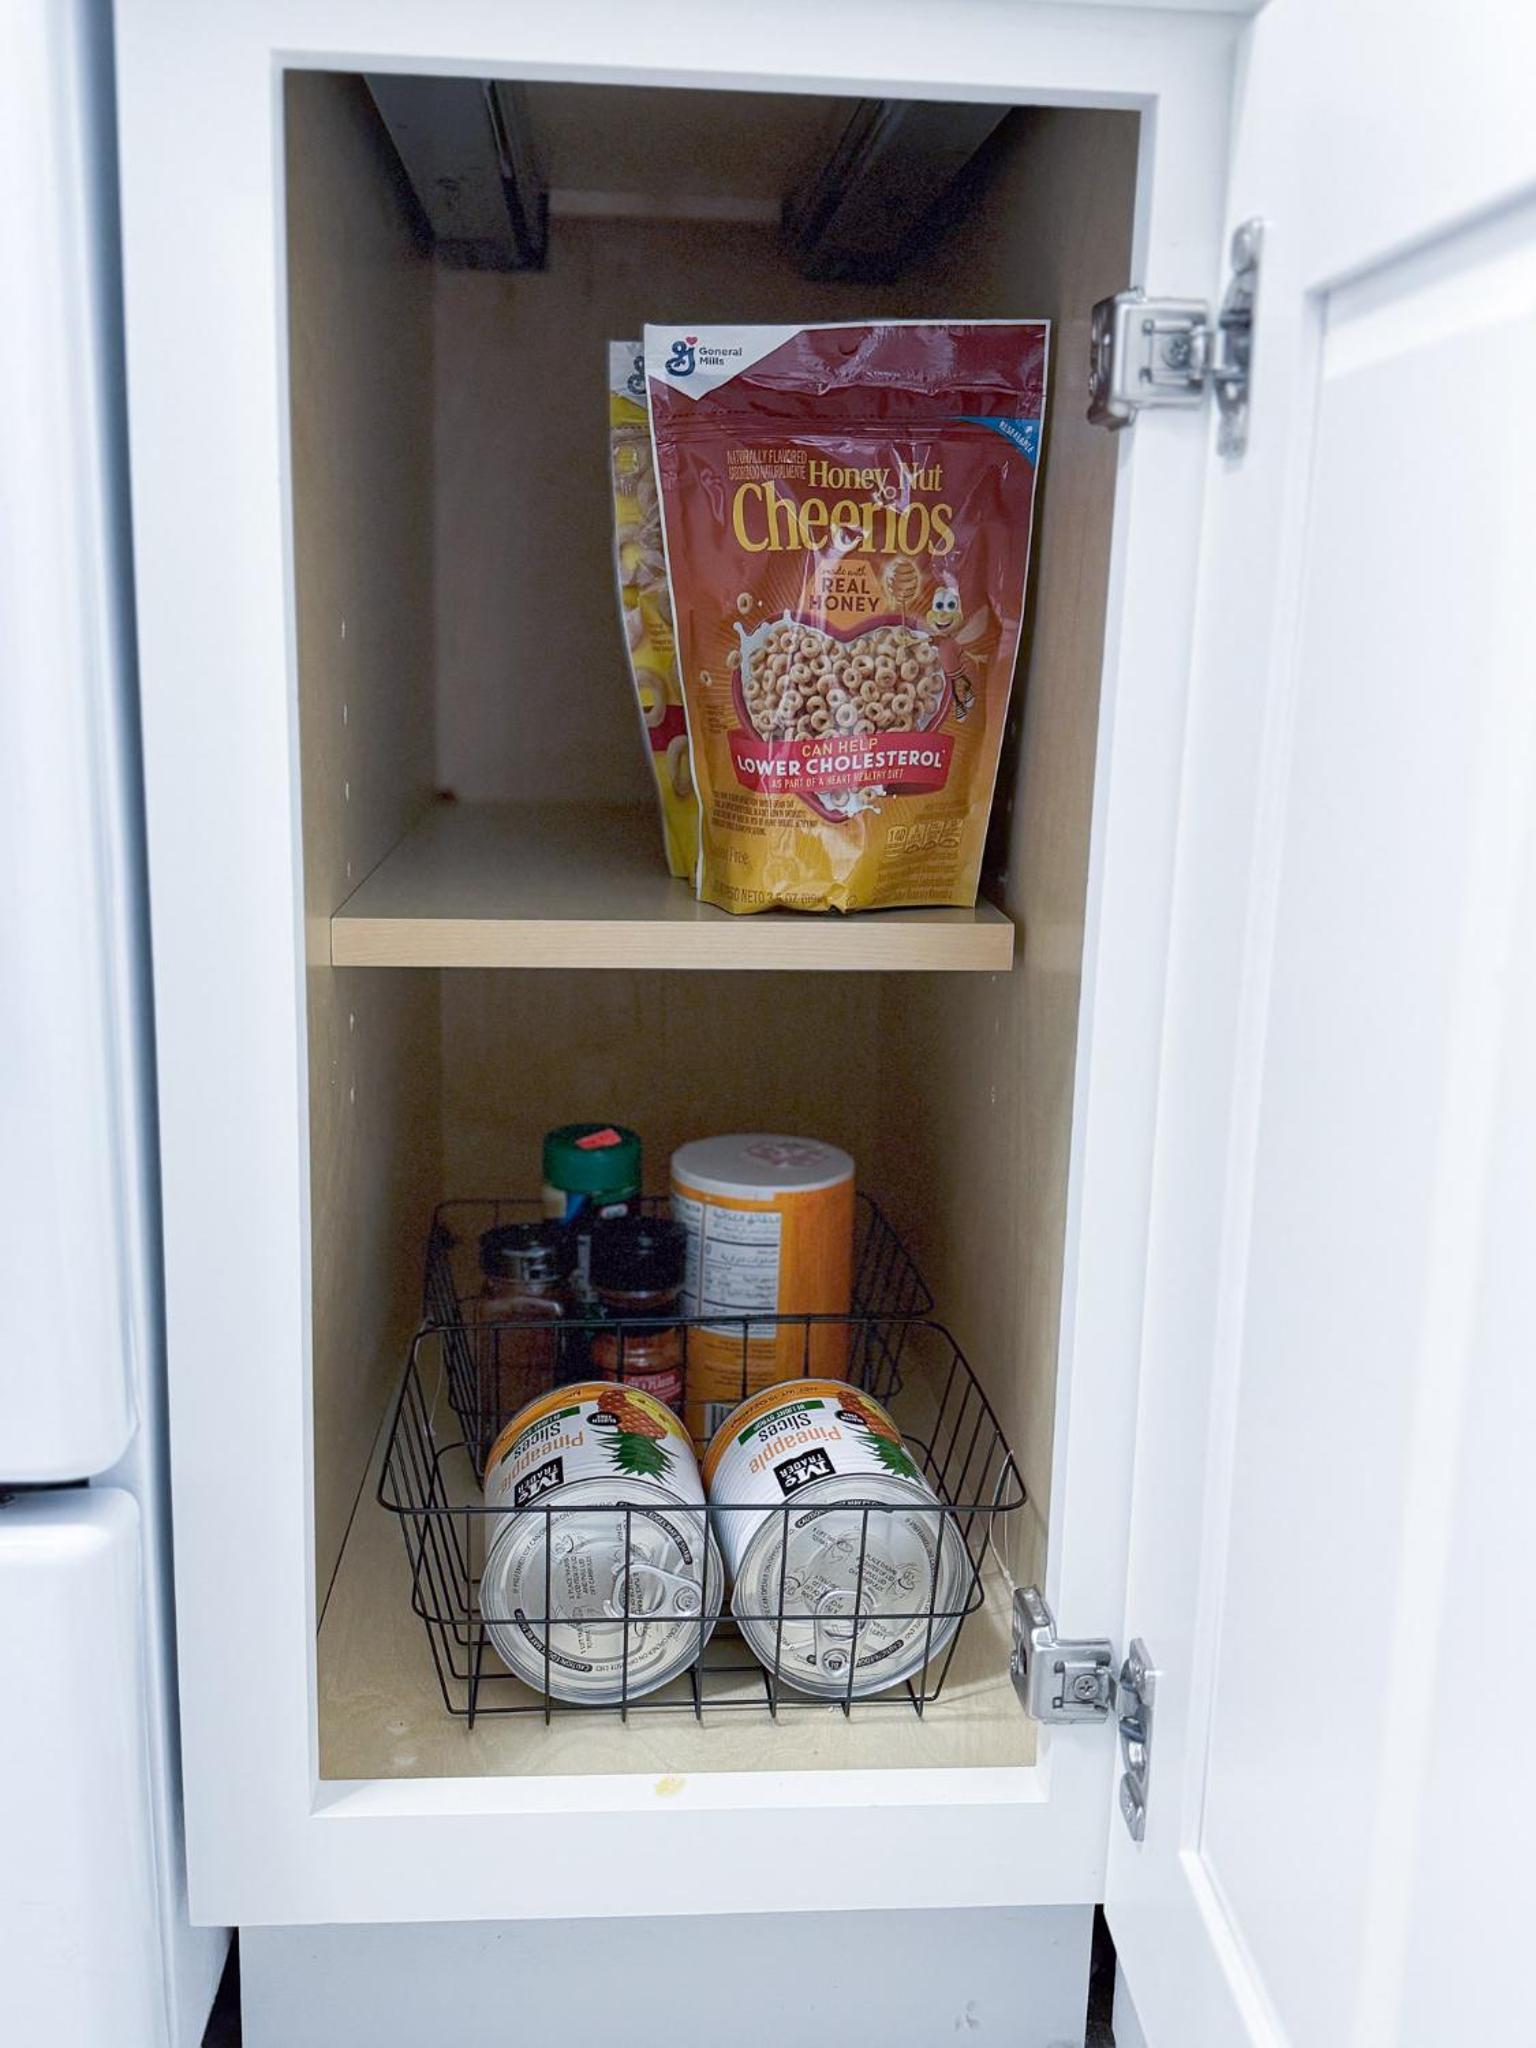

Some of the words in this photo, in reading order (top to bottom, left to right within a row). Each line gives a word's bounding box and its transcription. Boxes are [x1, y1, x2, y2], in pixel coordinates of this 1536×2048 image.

[698, 347, 742, 357] General
[699, 357, 725, 366] Mills
[808, 460, 890, 494] Honey
[898, 462, 944, 492] Nut
[732, 479, 956, 556] Cheerios
[821, 577, 871, 595] REAL
[808, 596, 880, 612] HONEY
[802, 740, 834, 758] CAN
[839, 738, 879, 753] HELP
[737, 755, 801, 777] LOWER
[771, 779, 783, 789] AS
[784, 777, 803, 789] PART
[806, 777, 817, 788] OF
[818, 777, 825, 787] A
[826, 774, 852, 785] HEART
[854, 770, 886, 783] HEALTHY
[758, 1412, 812, 1442] Slices
[514, 1422, 561, 1460] Slices
[748, 1425, 842, 1474] Pineapple
[779, 1453, 824, 1477] TRADER
[518, 1463, 559, 1493] TRADER
